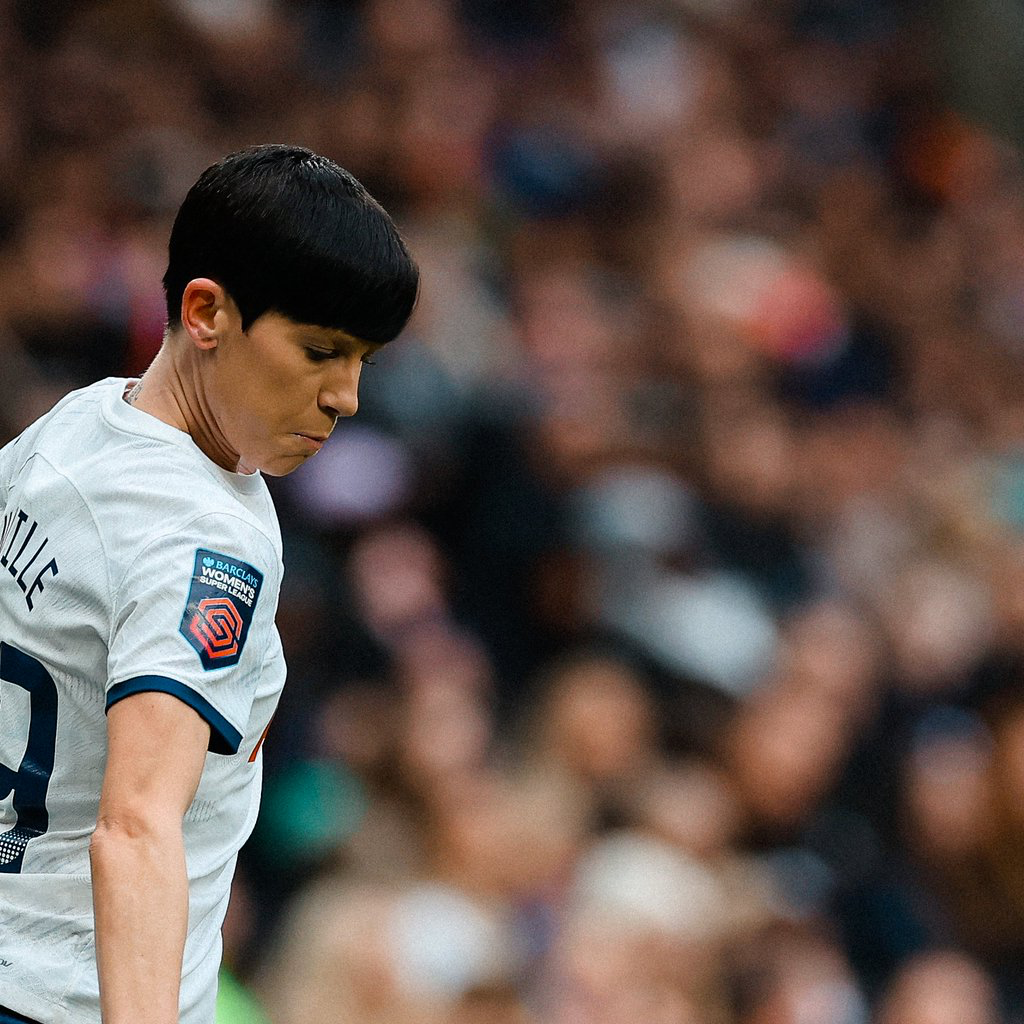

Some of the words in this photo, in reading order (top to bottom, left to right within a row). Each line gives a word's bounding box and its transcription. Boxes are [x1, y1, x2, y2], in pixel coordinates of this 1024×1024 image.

[201, 566, 255, 600] WOMEN'S
[216, 560, 258, 588] BARCLAYS
[199, 576, 227, 592] SUPER
[227, 587, 253, 608] LEAGUE
